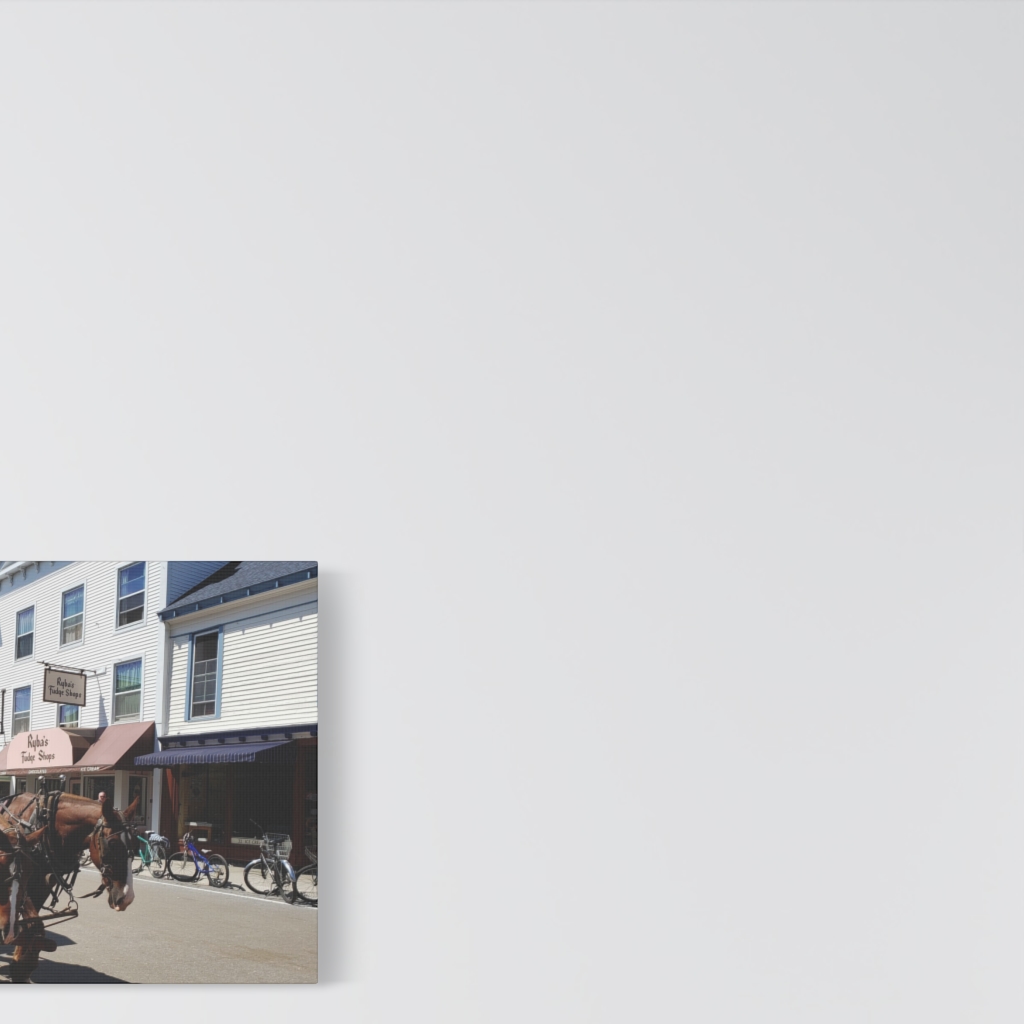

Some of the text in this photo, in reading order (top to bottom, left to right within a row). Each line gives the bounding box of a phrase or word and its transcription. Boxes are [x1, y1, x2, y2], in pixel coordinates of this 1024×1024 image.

[57, 676, 75, 689] Ryba's
[48, 685, 82, 699] Fudge Shops
[27, 733, 49, 752] Ryba's
[21, 749, 56, 764] Fudge Shops
